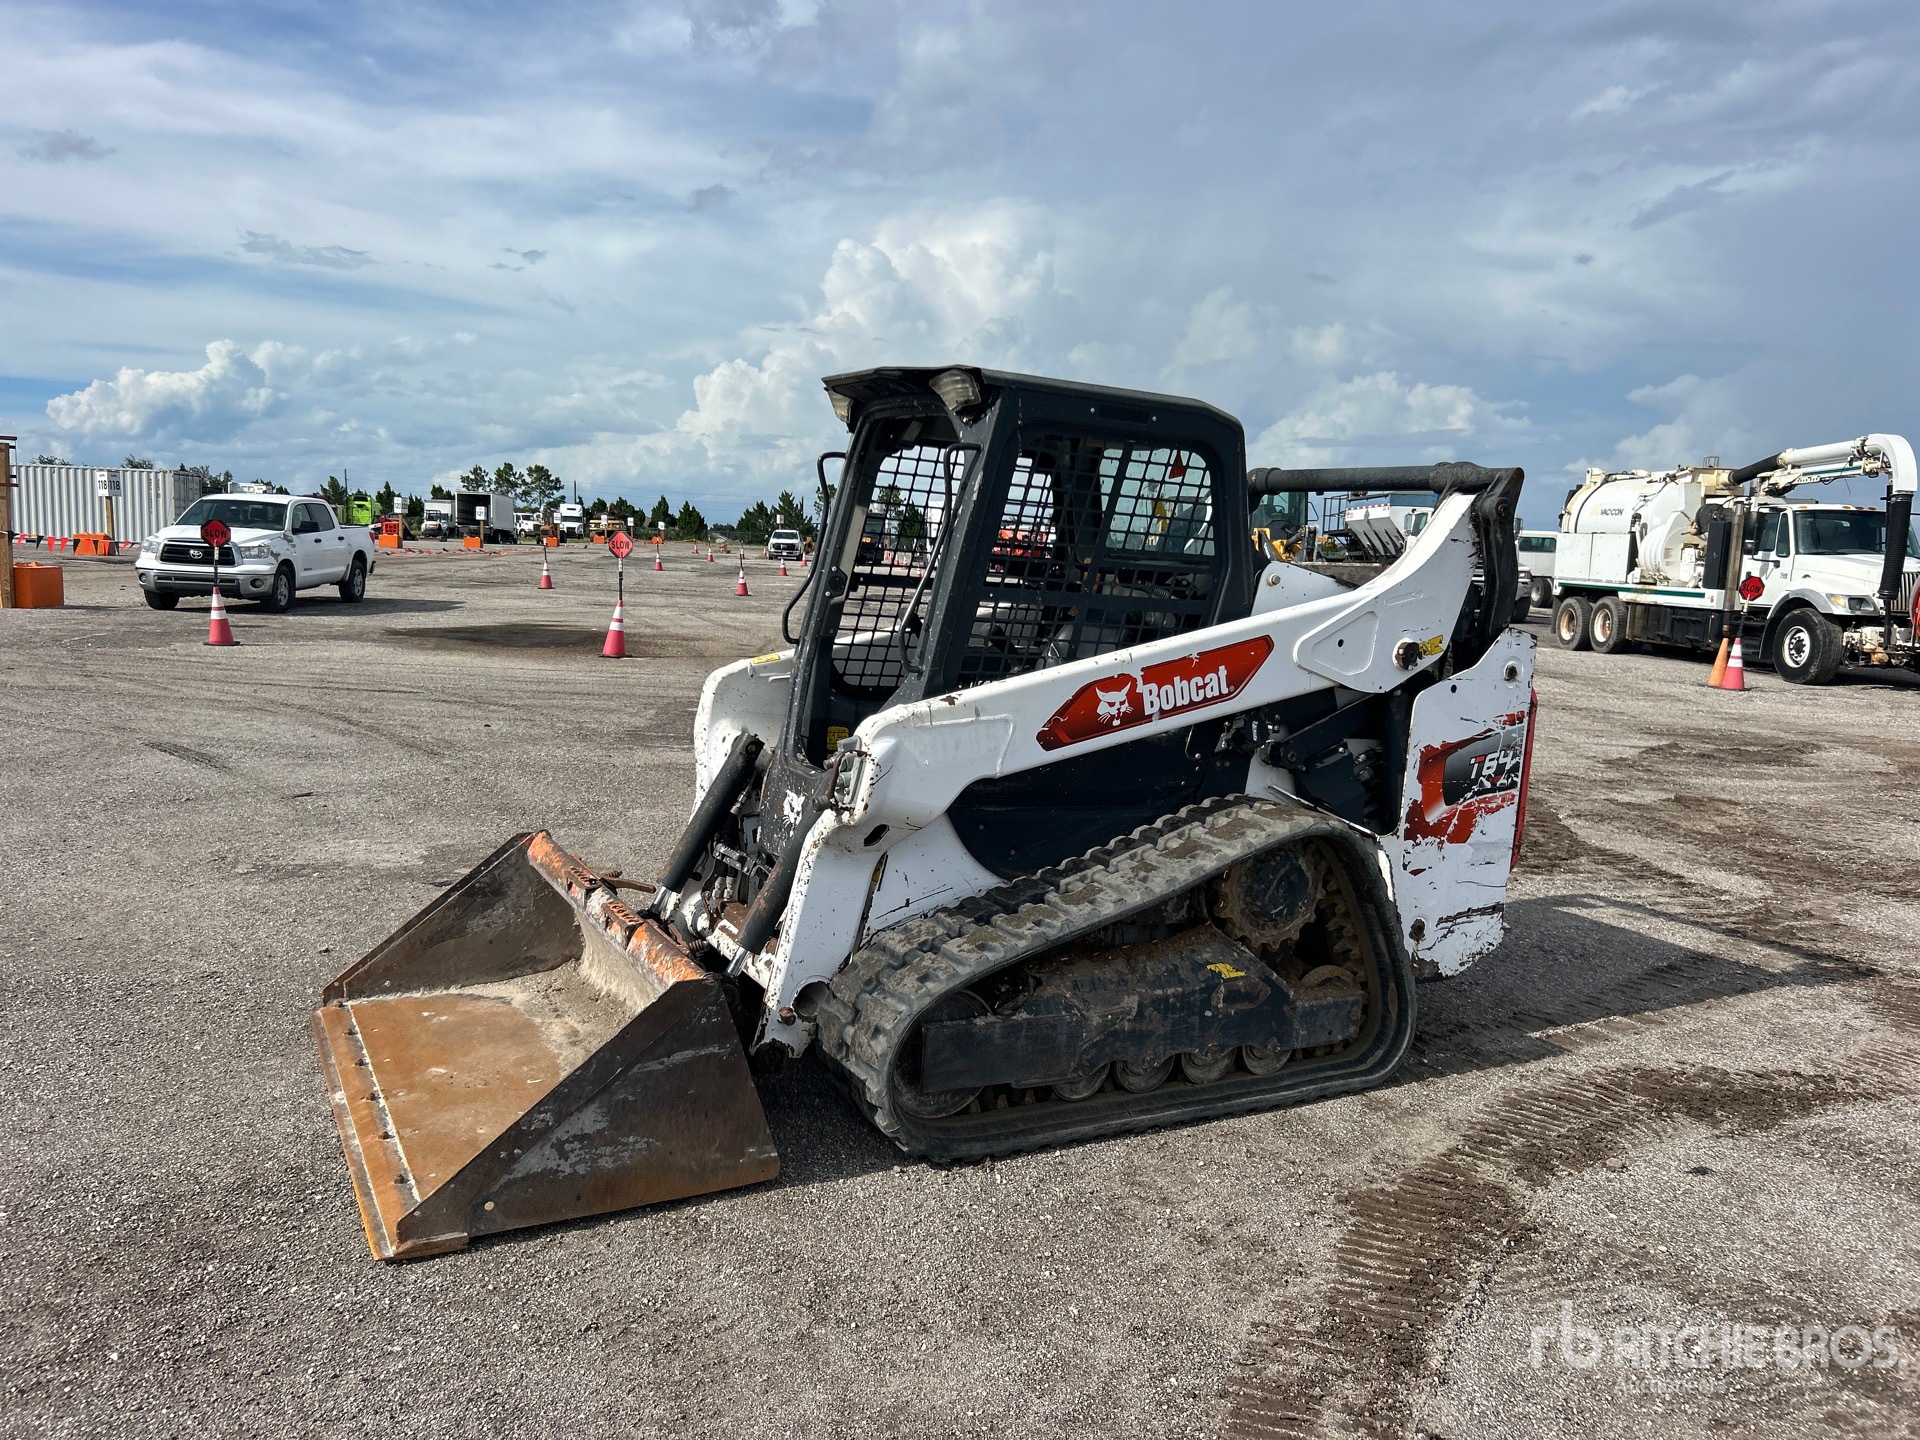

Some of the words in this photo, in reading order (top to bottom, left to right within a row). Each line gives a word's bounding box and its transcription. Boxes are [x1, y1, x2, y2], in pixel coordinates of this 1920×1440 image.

[98, 479, 108, 490] 118
[109, 479, 121, 491] 118
[204, 528, 228, 539] SLOW
[611, 540, 630, 550] SLOW
[1741, 583, 1762, 594] SLOW
[1142, 665, 1230, 716] Bobcat
[1469, 750, 1514, 780] T64
